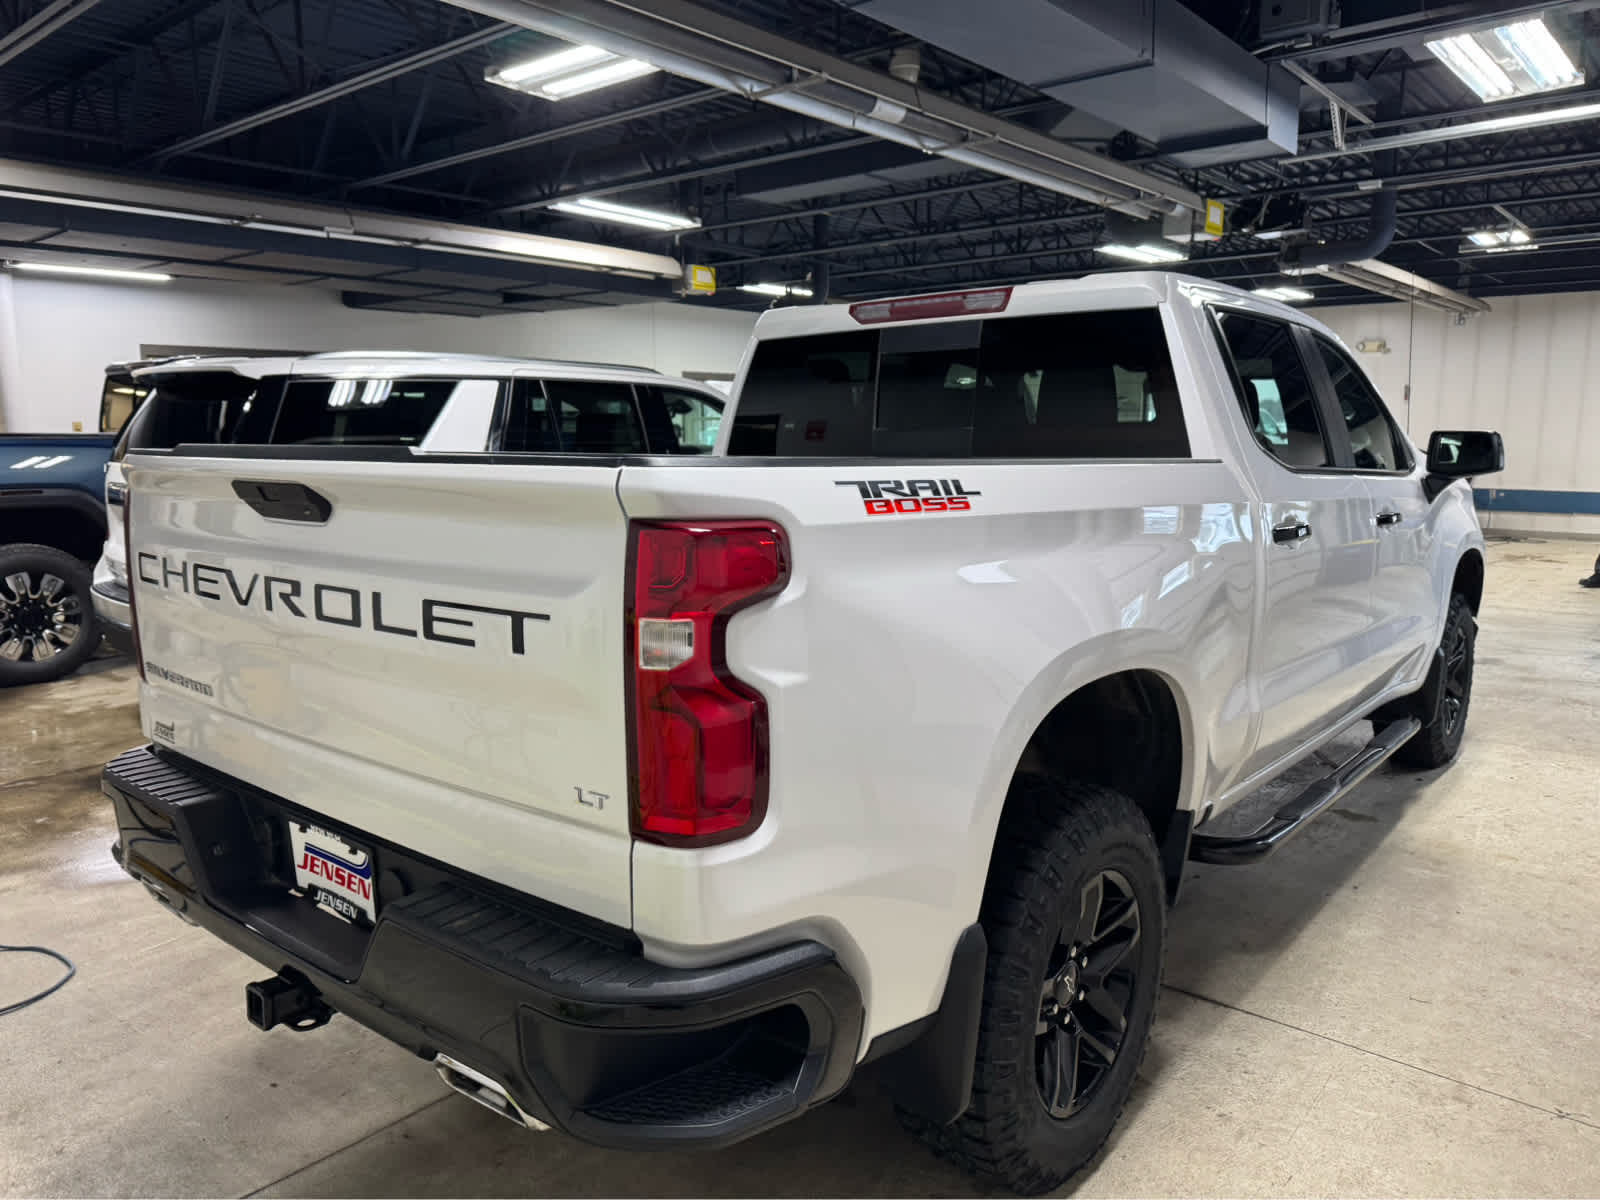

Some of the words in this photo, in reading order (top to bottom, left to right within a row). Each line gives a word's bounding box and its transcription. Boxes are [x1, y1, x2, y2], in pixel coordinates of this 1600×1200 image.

[834, 479, 981, 498] TRAIL
[864, 497, 971, 515] BOSS
[138, 552, 551, 655] CHEVROLET
[573, 786, 610, 810] LT
[297, 853, 371, 901] JENSEN
[314, 890, 358, 919] JENSEN
